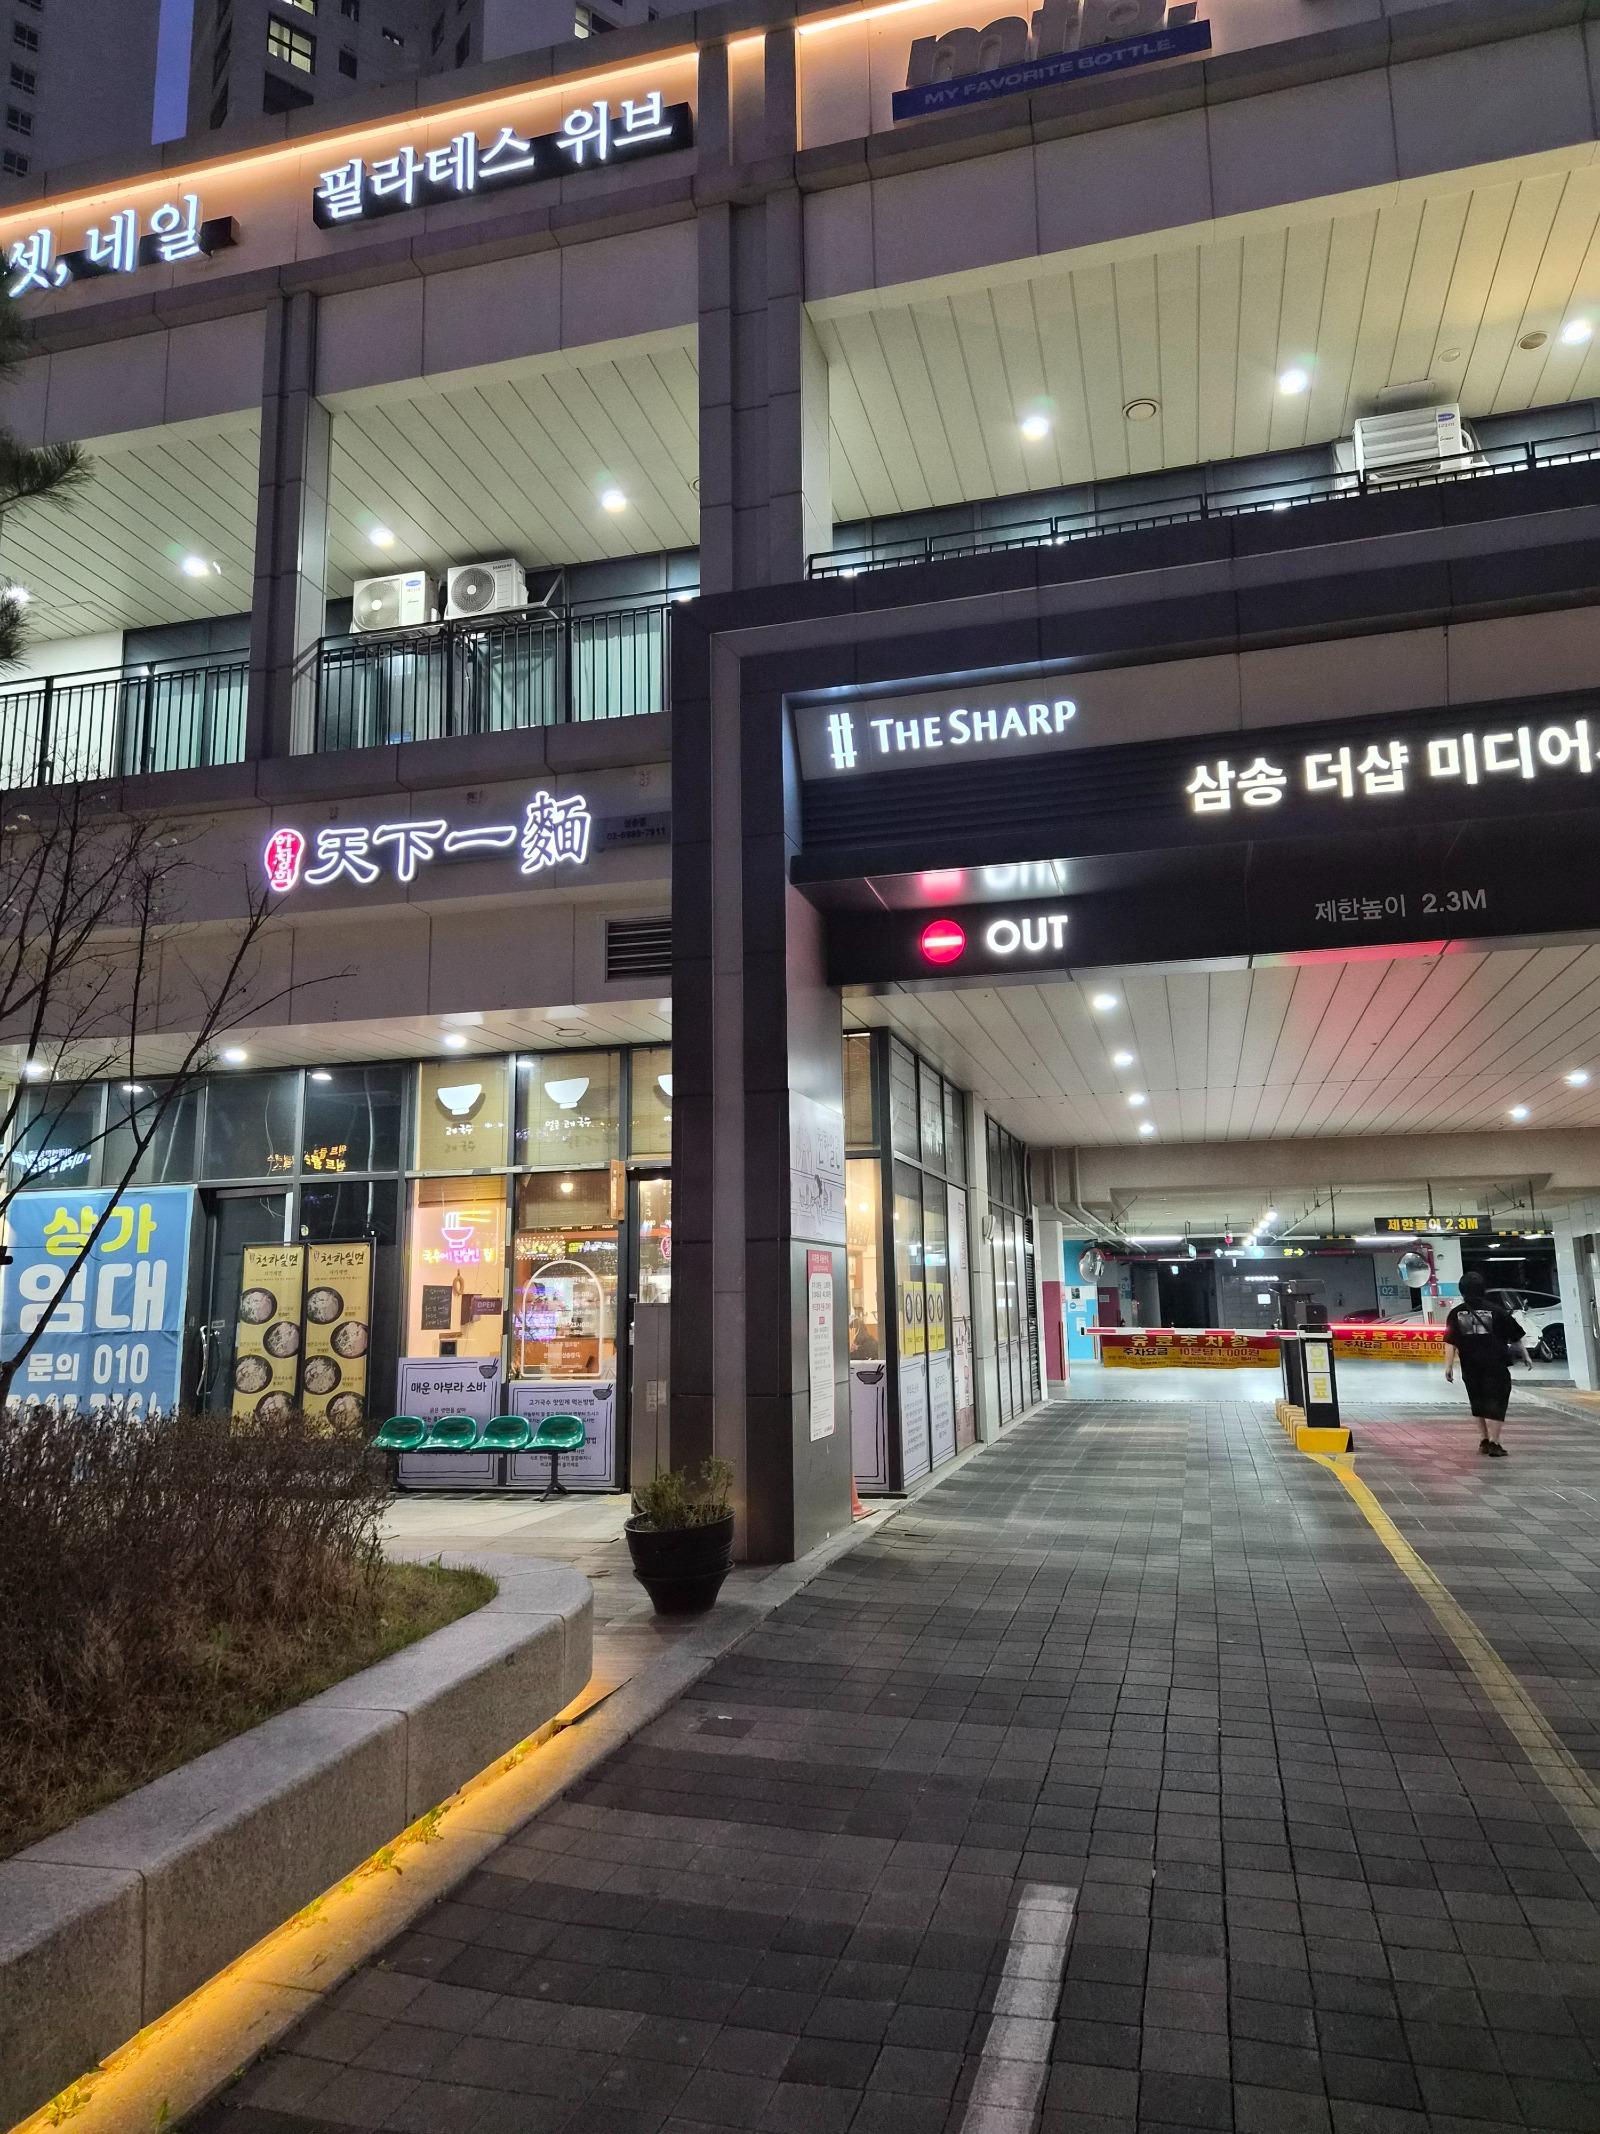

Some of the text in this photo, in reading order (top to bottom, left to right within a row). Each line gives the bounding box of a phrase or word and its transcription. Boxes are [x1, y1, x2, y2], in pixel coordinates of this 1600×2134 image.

[924, 39, 1177, 105] MY FAVORITE BOTTLE.
[318, 91, 675, 220] 필라테스 위브
[86, 194, 202, 272] 네일
[1186, 719, 1600, 813] 삼송 더샵 미디어
[1315, 888, 1487, 922] 제한높이 2.3M
[986, 914, 1069, 954] OUT
[43, 1203, 157, 1256] 상가
[1387, 1217, 1478, 1231] 제한높이 2.3M
[256, 1251, 298, 1267] 천하일면
[321, 1250, 364, 1266] 천하일면
[19, 1259, 168, 1333] 임대
[477, 1301, 496, 1309] OPEN
[1382, 1287, 1393, 1295] 02
[1123, 1347, 1168, 1356] 주차요금
[1131, 1335, 1250, 1347] 유료주차장
[27, 1344, 149, 1384] 문의 010
[411, 1381, 487, 1394] 매운 아부라 소바
